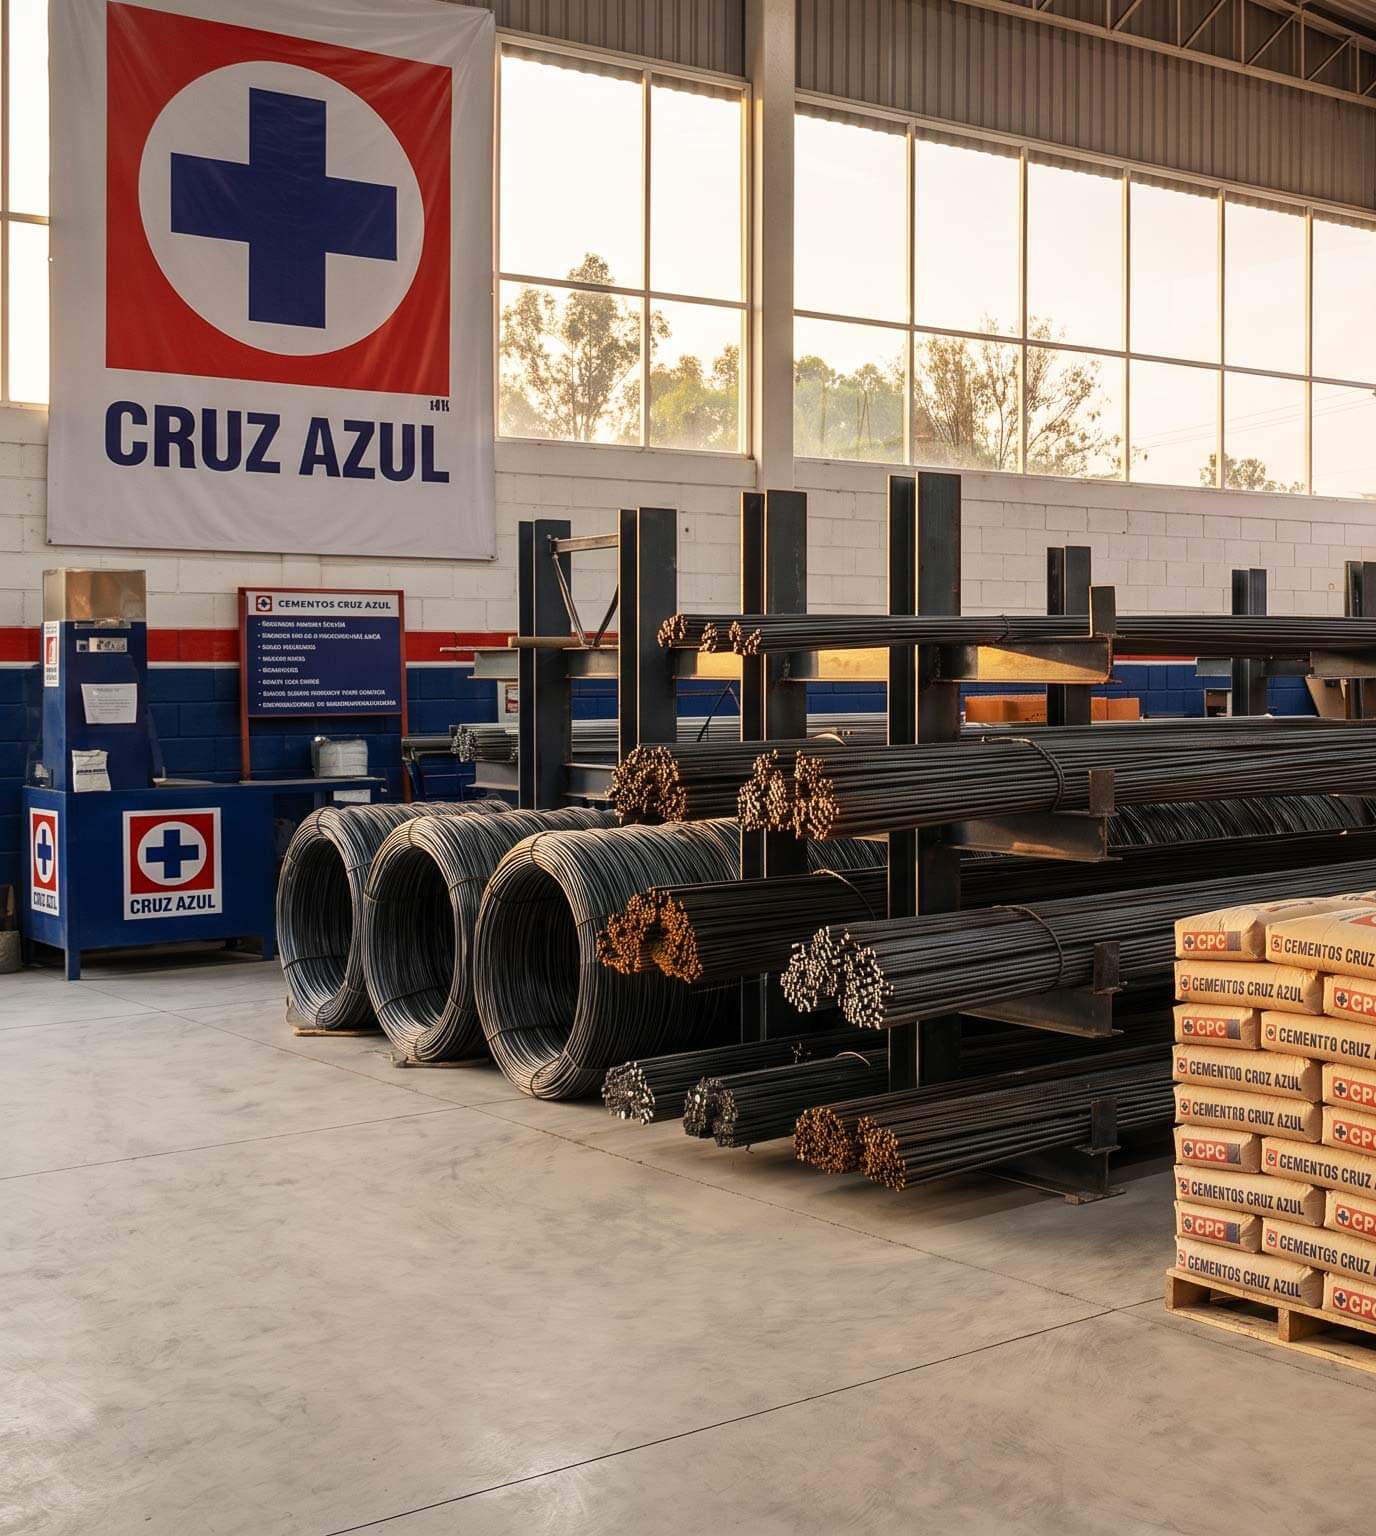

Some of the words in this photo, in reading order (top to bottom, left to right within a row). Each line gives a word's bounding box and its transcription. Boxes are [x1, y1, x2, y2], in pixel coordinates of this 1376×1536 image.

[105, 401, 280, 474] CRUZ
[298, 417, 450, 483] AZUL
[278, 600, 335, 608] CEMENTOS
[338, 600, 362, 609] CRUZ
[364, 601, 391, 609] AZUL
[130, 897, 172, 914] CRUZ
[176, 895, 216, 911] AZUL
[1197, 934, 1225, 949] CPC
[1284, 939, 1342, 961] CEMENTOS
[1346, 948, 1376, 967] CRUZ
[1247, 982, 1274, 998] CRUZ
[1196, 1021, 1226, 1036] CPC
[1340, 1039, 1370, 1059] CRUZ
[1274, 1074, 1302, 1091] AZUL
[1248, 1109, 1274, 1126] CRUZ
[1278, 1114, 1304, 1132] AZUL
[1196, 1143, 1226, 1160] CPC
[1280, 1154, 1338, 1180] CEMENTOS
[1342, 1168, 1372, 1188] CRUZ
[1192, 1182, 1244, 1203] CEMENTOS
[1277, 1197, 1304, 1216] AZUL
[1196, 1220, 1224, 1238] CPC
[1340, 1252, 1370, 1274] CRUZ
